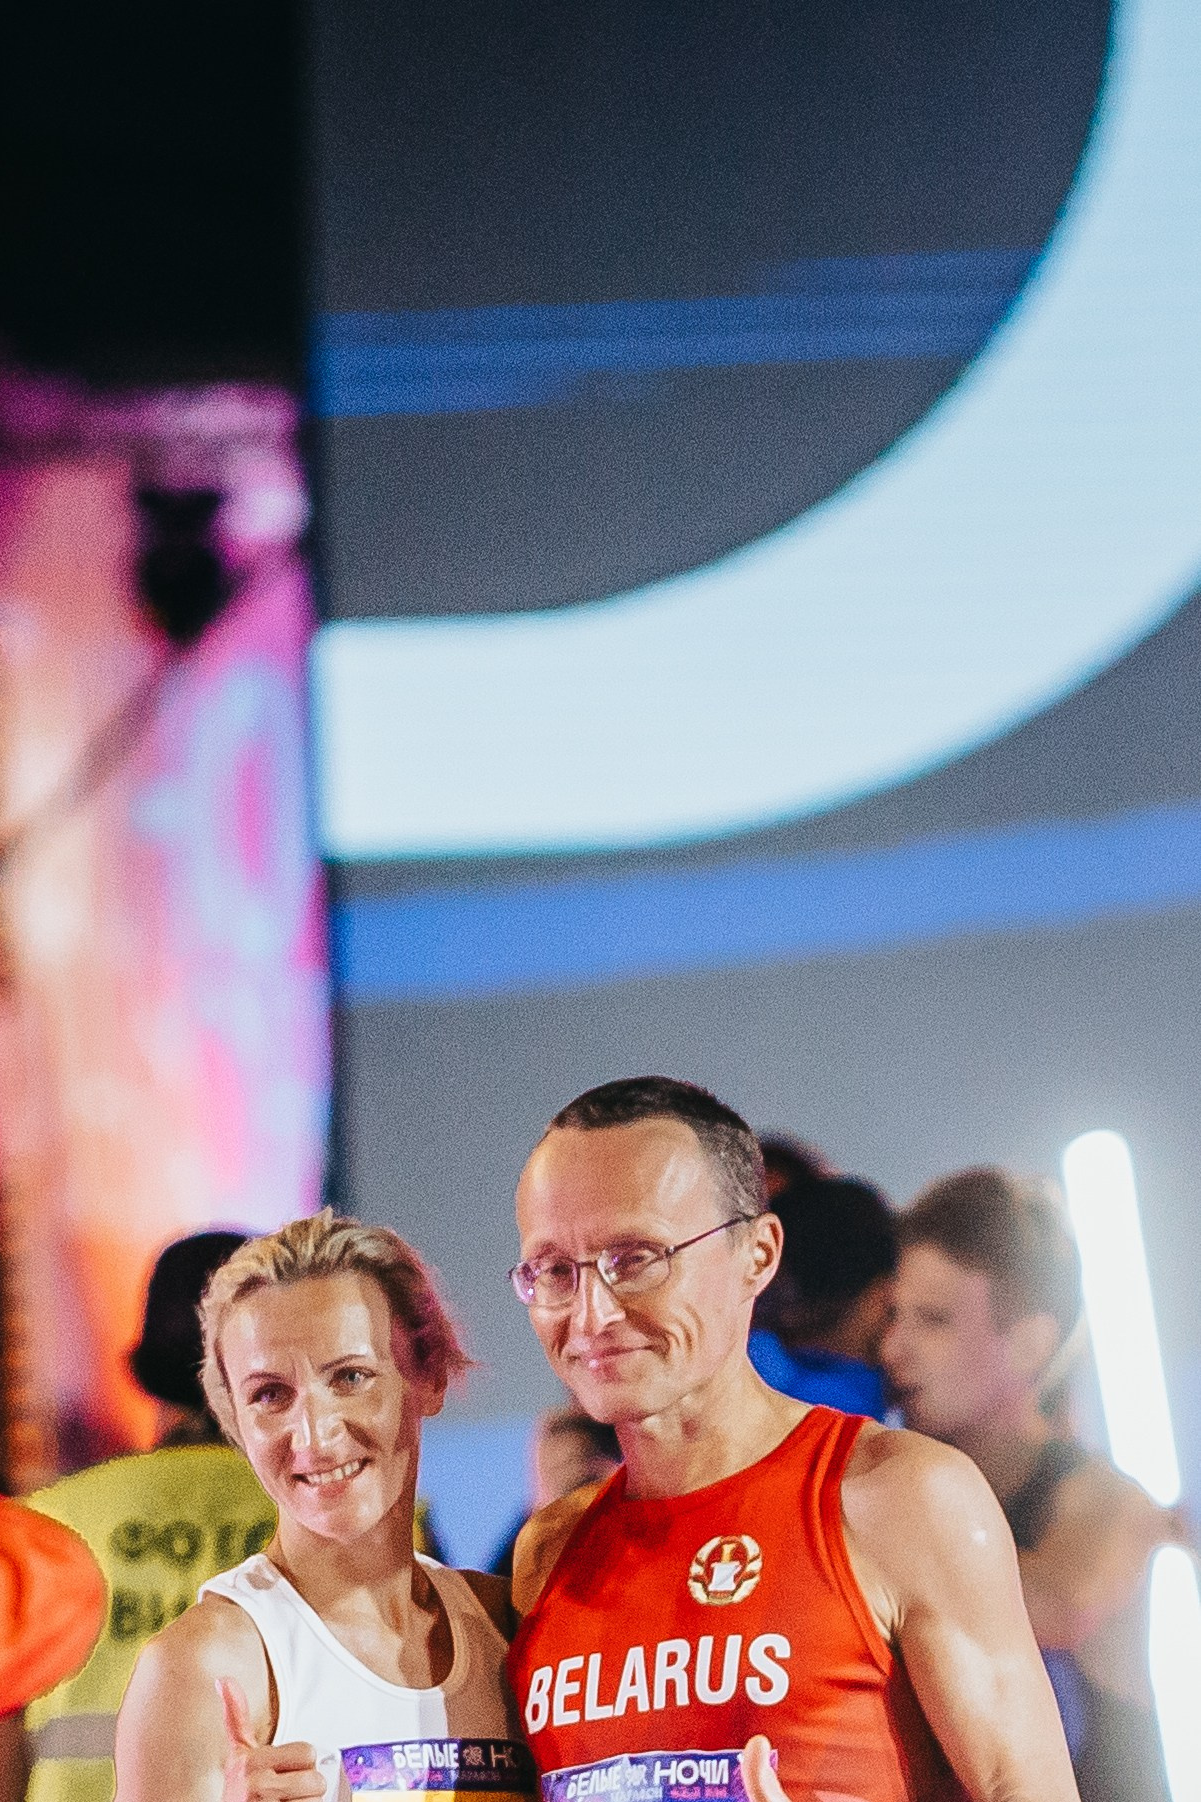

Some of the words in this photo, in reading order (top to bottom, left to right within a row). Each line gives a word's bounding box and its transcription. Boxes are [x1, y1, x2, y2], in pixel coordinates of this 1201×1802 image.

[525, 1633, 791, 1735] BELARUS
[391, 1743, 459, 1769] БЕЛЫЕ
[566, 1764, 622, 1799] БЕЛЫЕ
[654, 1758, 730, 1785] НОЧИ
